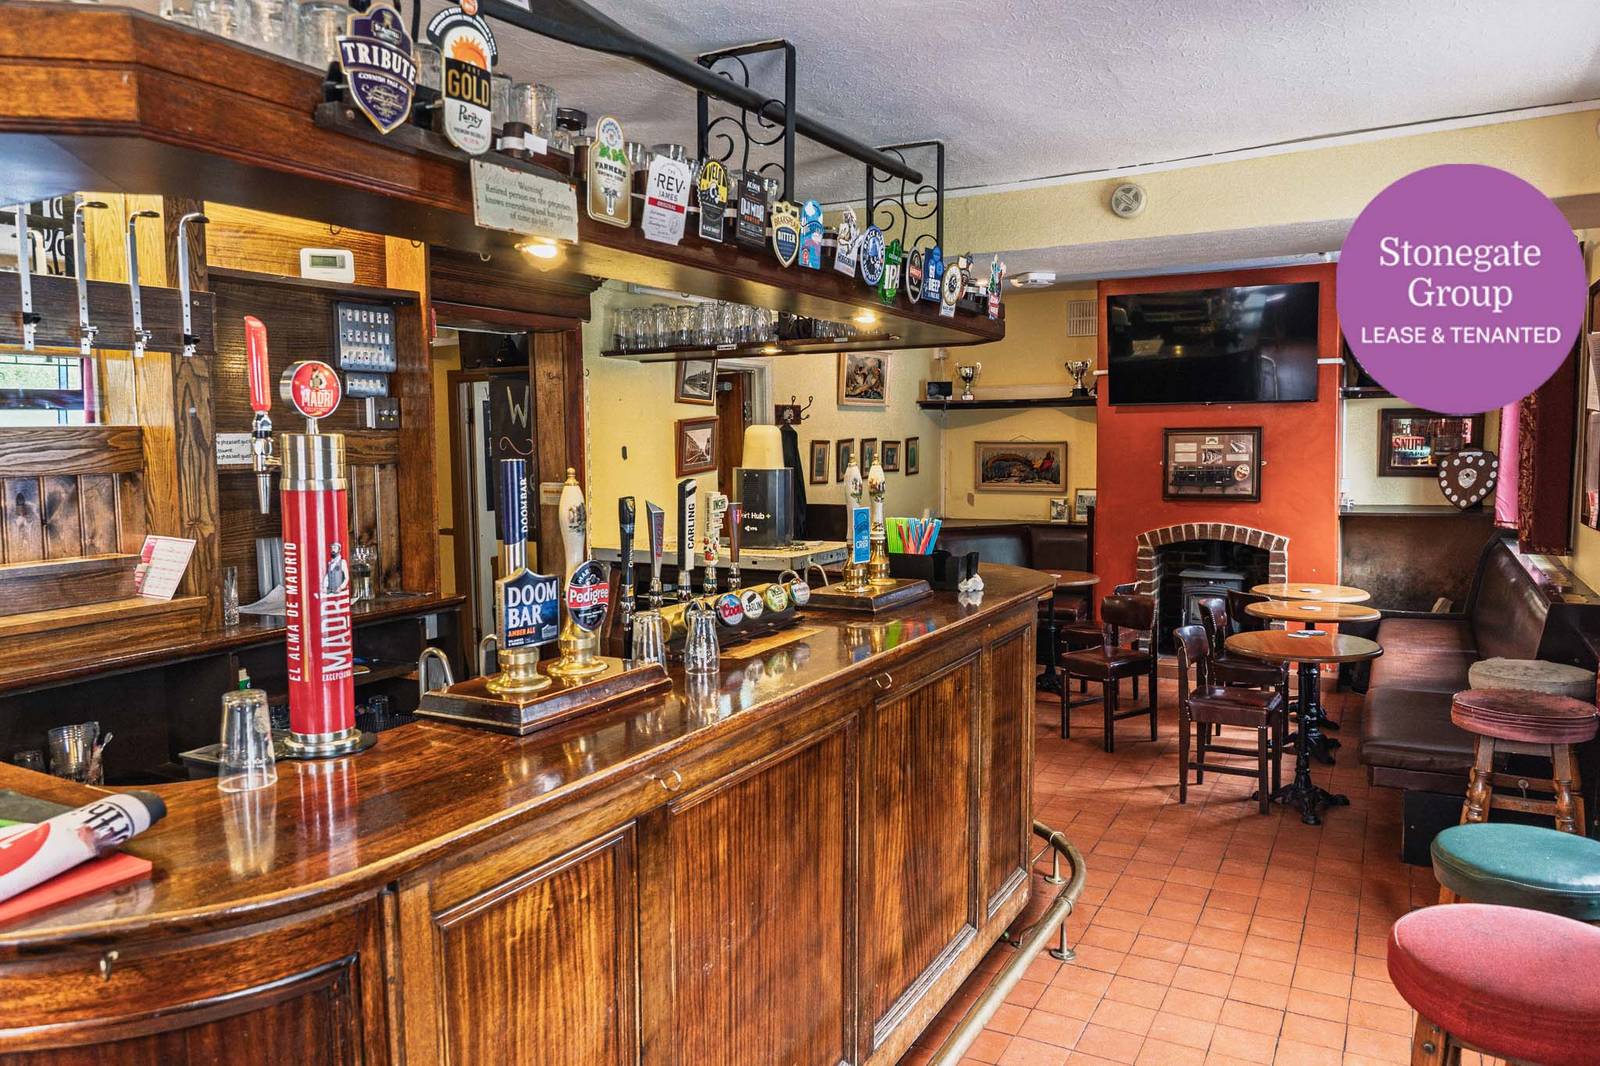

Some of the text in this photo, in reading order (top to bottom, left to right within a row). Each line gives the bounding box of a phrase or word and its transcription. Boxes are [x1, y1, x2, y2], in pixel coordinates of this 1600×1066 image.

[341, 42, 416, 87] TRIBUTE
[447, 69, 490, 107] GOLD
[458, 104, 483, 129] Purity
[595, 161, 627, 178] FARMERS
[657, 190, 678, 202] JAMES
[777, 231, 796, 243] BITTER
[884, 264, 900, 290] IPA
[519, 477, 529, 533] DOOM BAR
[751, 511, 765, 520] Hub
[687, 503, 695, 550] CARLING
[507, 580, 557, 608] DOOM
[569, 588, 608, 606] Pedigree
[284, 542, 301, 682] EL ALMA DE MADRID
[507, 604, 543, 630] BAR
[508, 626, 536, 638] AMBER ALE
